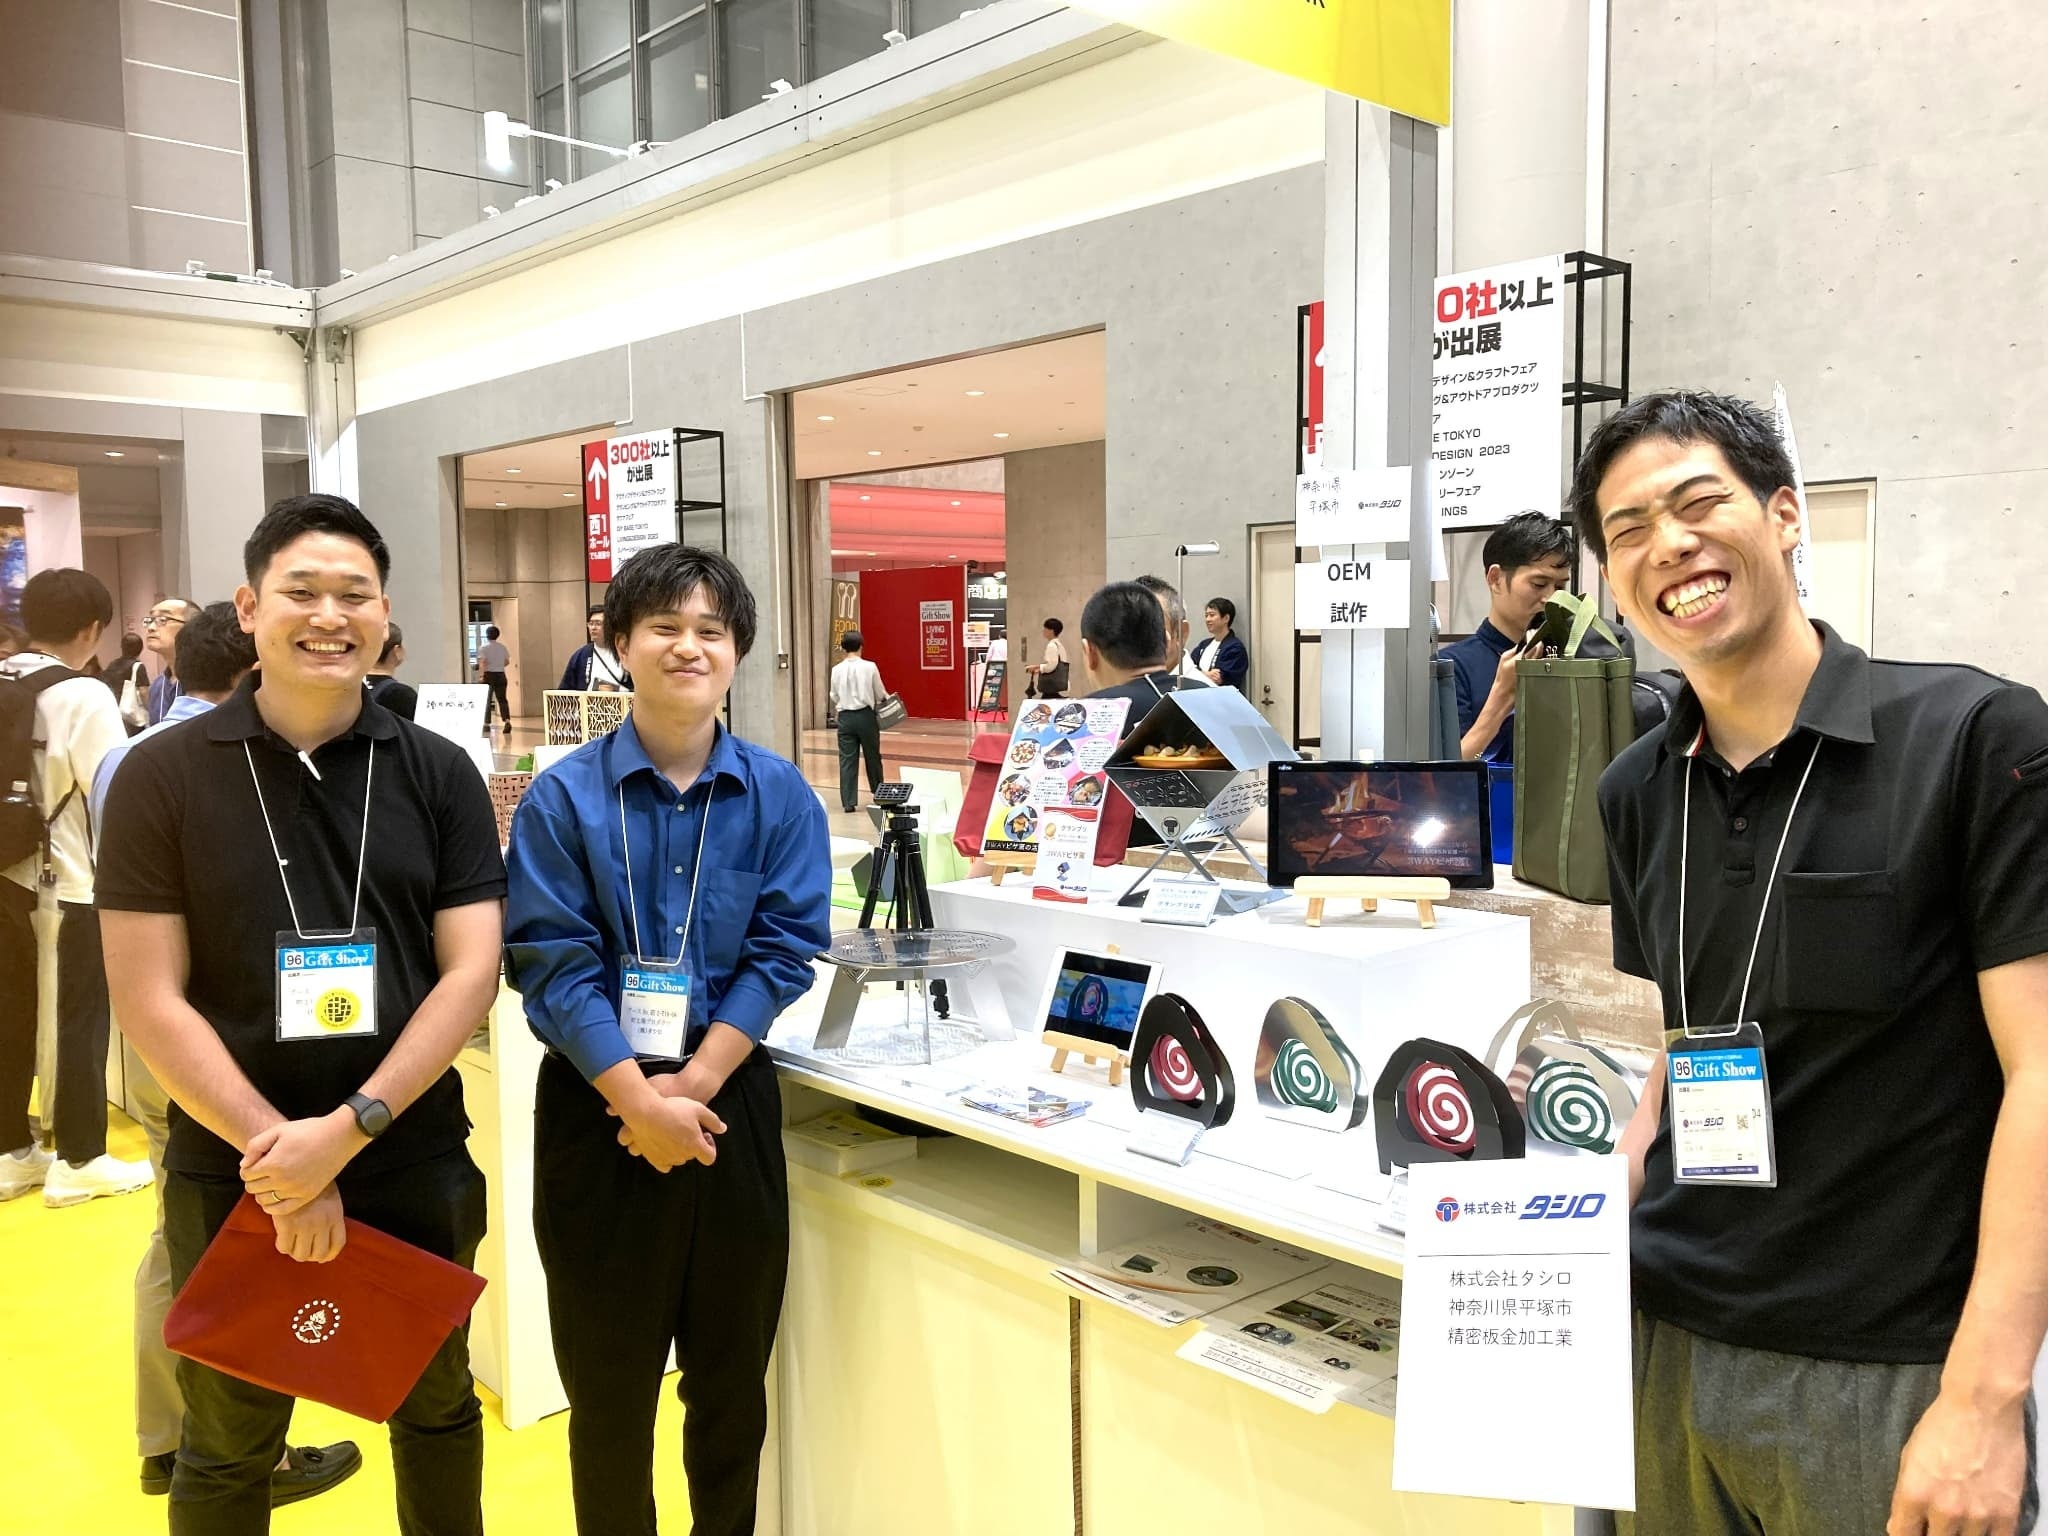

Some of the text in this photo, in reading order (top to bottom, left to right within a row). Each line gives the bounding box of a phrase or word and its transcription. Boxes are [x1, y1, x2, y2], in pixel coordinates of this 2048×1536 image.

[1443, 428, 1481, 441] TOKYO
[611, 438, 670, 465] 300社以上
[1479, 444, 1510, 457] 2023
[627, 463, 653, 483] が出展
[1379, 500, 1402, 509] タシロ
[1441, 506, 1468, 517] INGS
[589, 535, 610, 549] ホール
[1327, 562, 1371, 581] OEM
[922, 611, 951, 620] Gift Show
[1330, 601, 1368, 624] 試作
[286, 951, 369, 967] 96 Gift Show
[627, 976, 638, 986] 96
[640, 979, 659, 991] Gift
[660, 981, 685, 992] Show
[1675, 1061, 1757, 1078] 96 Gift Show
[1464, 1193, 1607, 1220] 株式会社 タシロ
[1449, 1270, 1571, 1287] 株式会社タシロ
[1449, 1298, 1573, 1317] 神奈川県平塚市
[1448, 1328, 1573, 1346] 精密板金加工業
